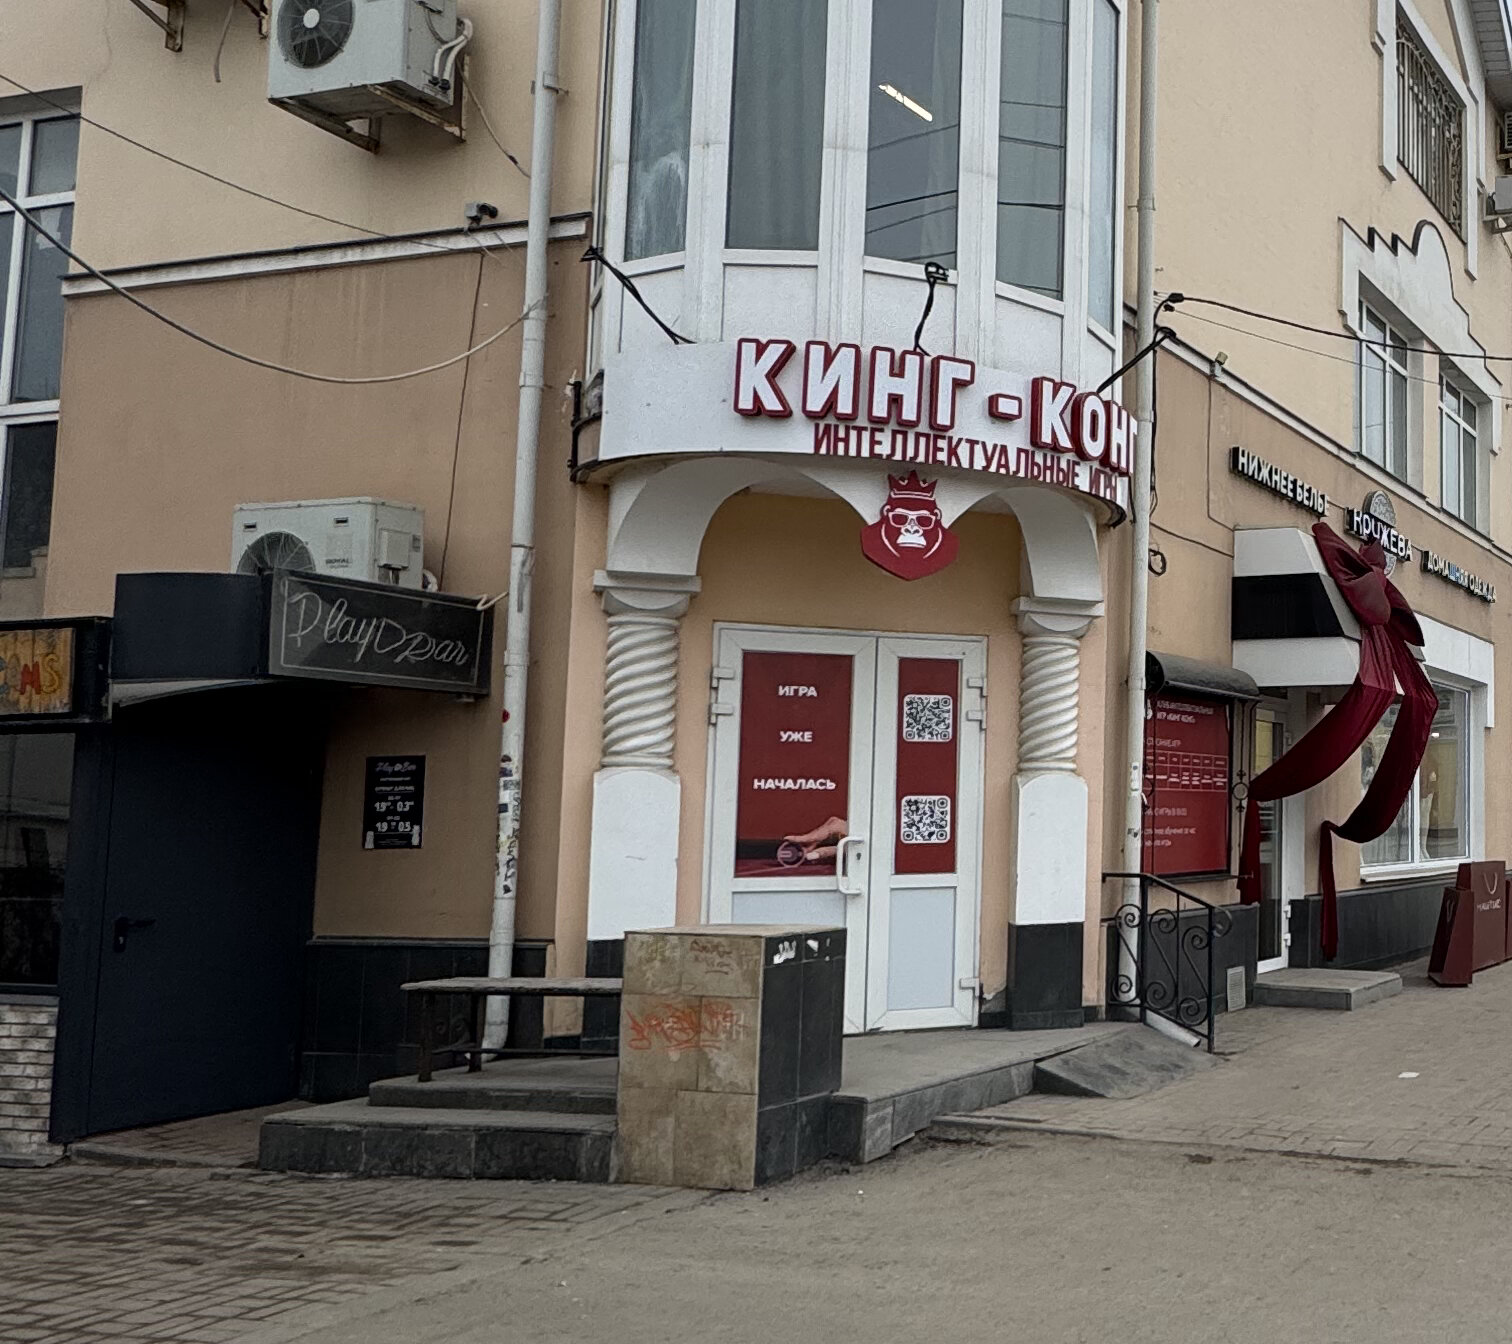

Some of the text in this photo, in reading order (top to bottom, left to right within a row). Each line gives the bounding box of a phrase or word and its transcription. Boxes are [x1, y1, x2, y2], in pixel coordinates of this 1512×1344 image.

[814, 422, 1081, 489] ИНТЕЛЛЕКТУАЛЬНЫЕ
[1238, 446, 1294, 498] НИЖНЕЕ
[778, 685, 818, 697] ИГРА
[779, 730, 813, 743] УЖЕ
[753, 778, 836, 791] НАЧАЛАСЬ
